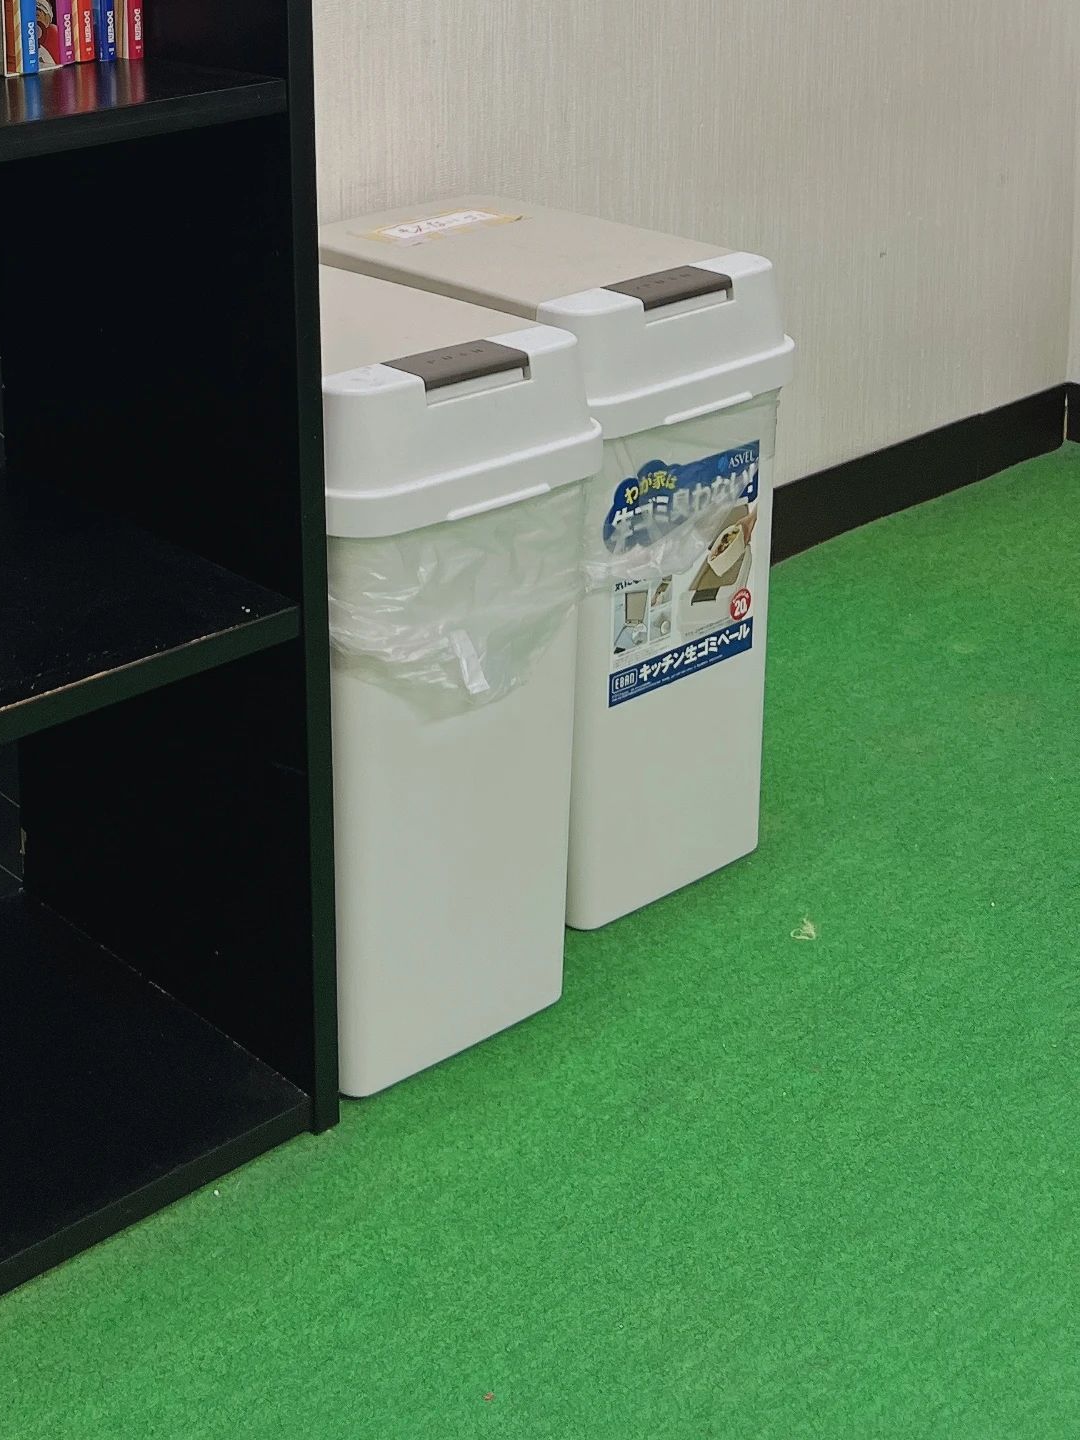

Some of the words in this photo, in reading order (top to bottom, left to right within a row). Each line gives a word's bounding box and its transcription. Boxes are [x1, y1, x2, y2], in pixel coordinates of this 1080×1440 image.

[727, 449, 755, 469] ASVEL
[625, 470, 678, 505] わが家は
[638, 622, 751, 682] キッチン生ゴミペール
